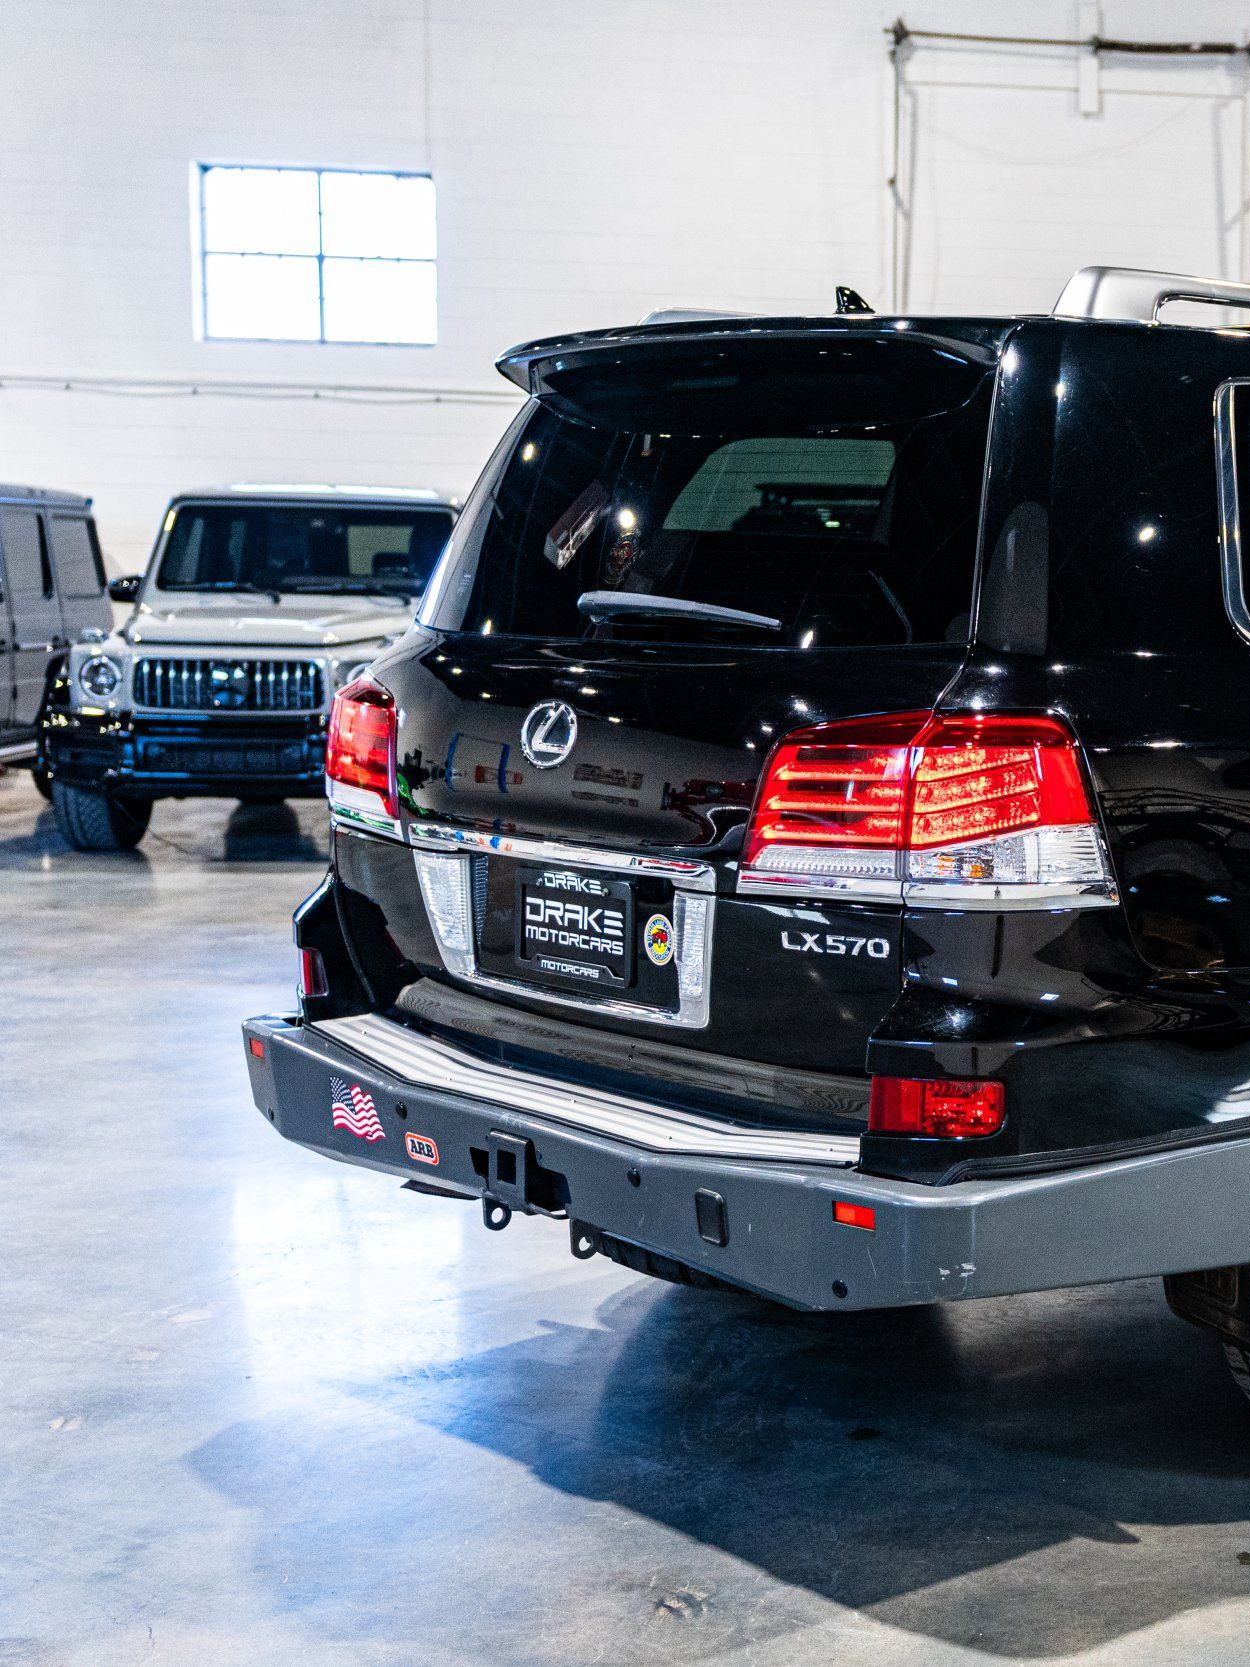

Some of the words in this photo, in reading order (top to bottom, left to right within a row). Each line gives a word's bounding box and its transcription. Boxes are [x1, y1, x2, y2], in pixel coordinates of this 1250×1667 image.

[543, 872, 602, 896] DRAKE
[525, 897, 624, 938] DRAKE
[525, 924, 624, 957] MOTORCARS
[540, 958, 601, 980] MOTORCARS
[410, 1139, 435, 1159] ARB
